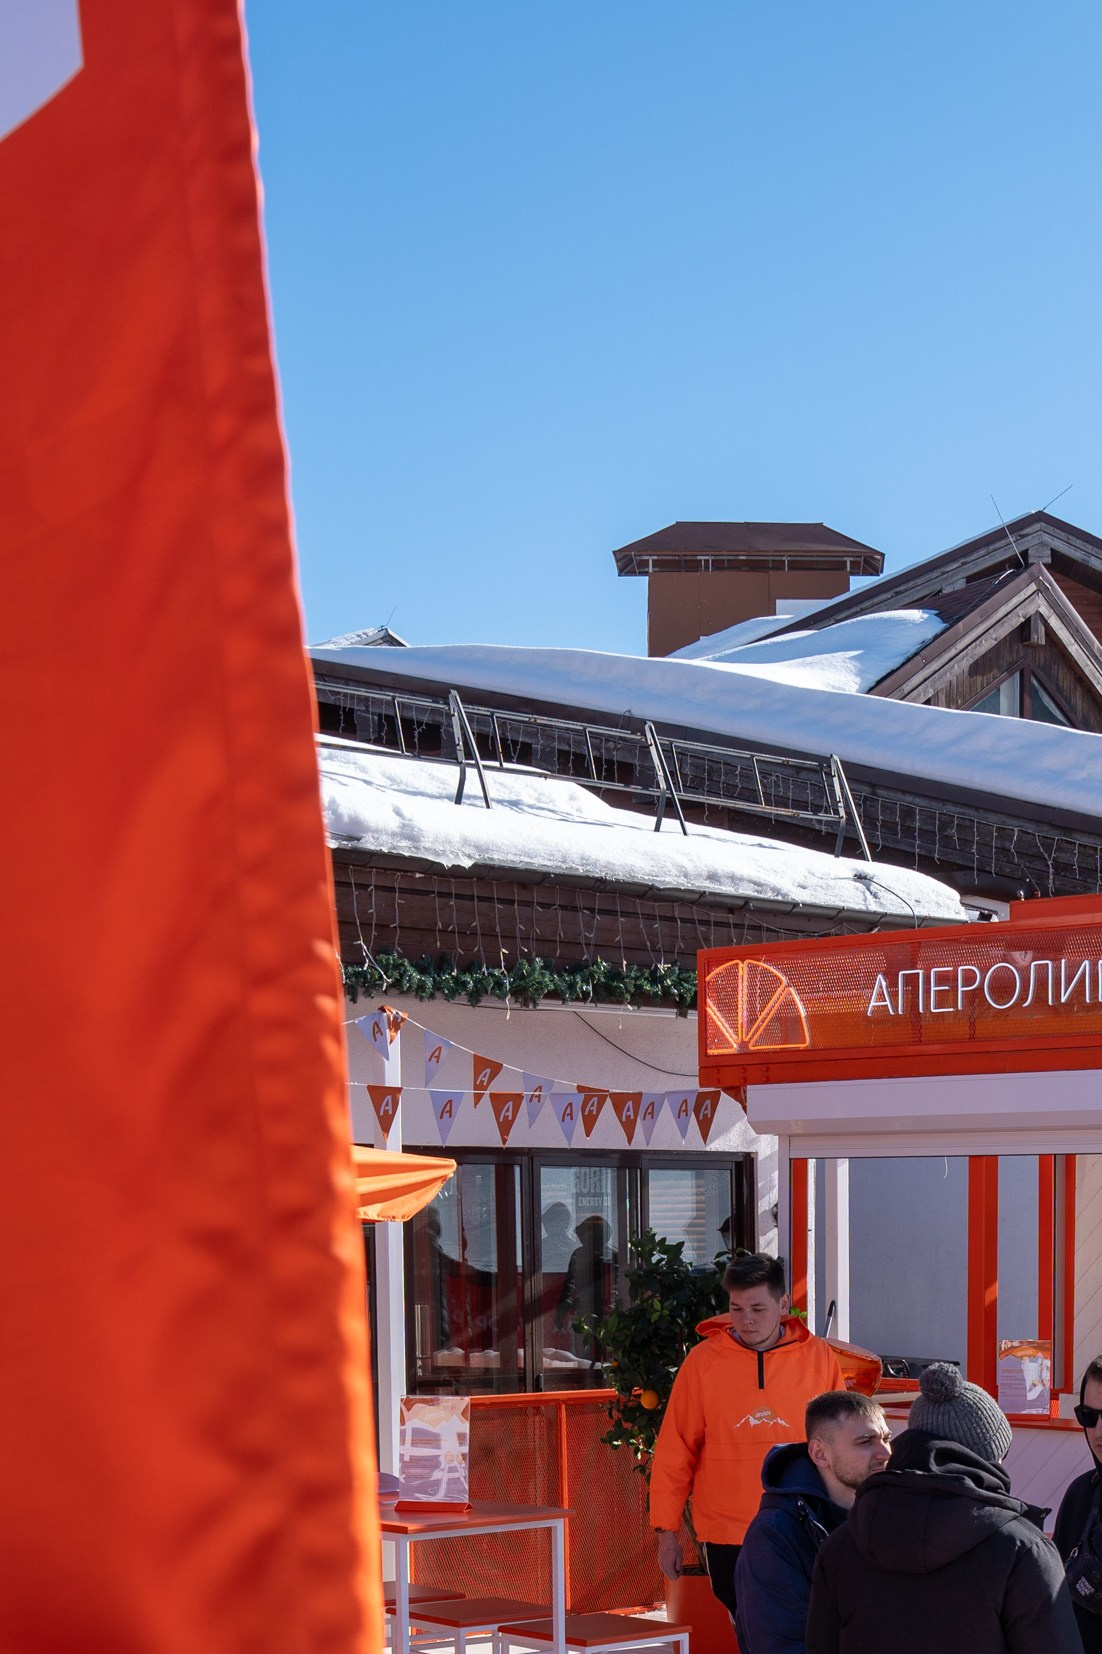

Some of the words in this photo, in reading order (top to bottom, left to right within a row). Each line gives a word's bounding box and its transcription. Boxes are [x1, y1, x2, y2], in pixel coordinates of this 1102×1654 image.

[371, 1020, 383, 1042] A
[428, 1046, 442, 1064] A
[476, 1069, 491, 1086] A
[529, 1085, 543, 1104] A
[379, 1096, 394, 1117] A
[440, 1099, 453, 1120] A
[500, 1101, 514, 1122] A
[562, 1102, 574, 1123] A
[584, 1097, 598, 1116] A
[622, 1101, 634, 1122] A
[642, 1102, 655, 1121] A
[676, 1098, 689, 1119] A
[700, 1100, 711, 1120] A
